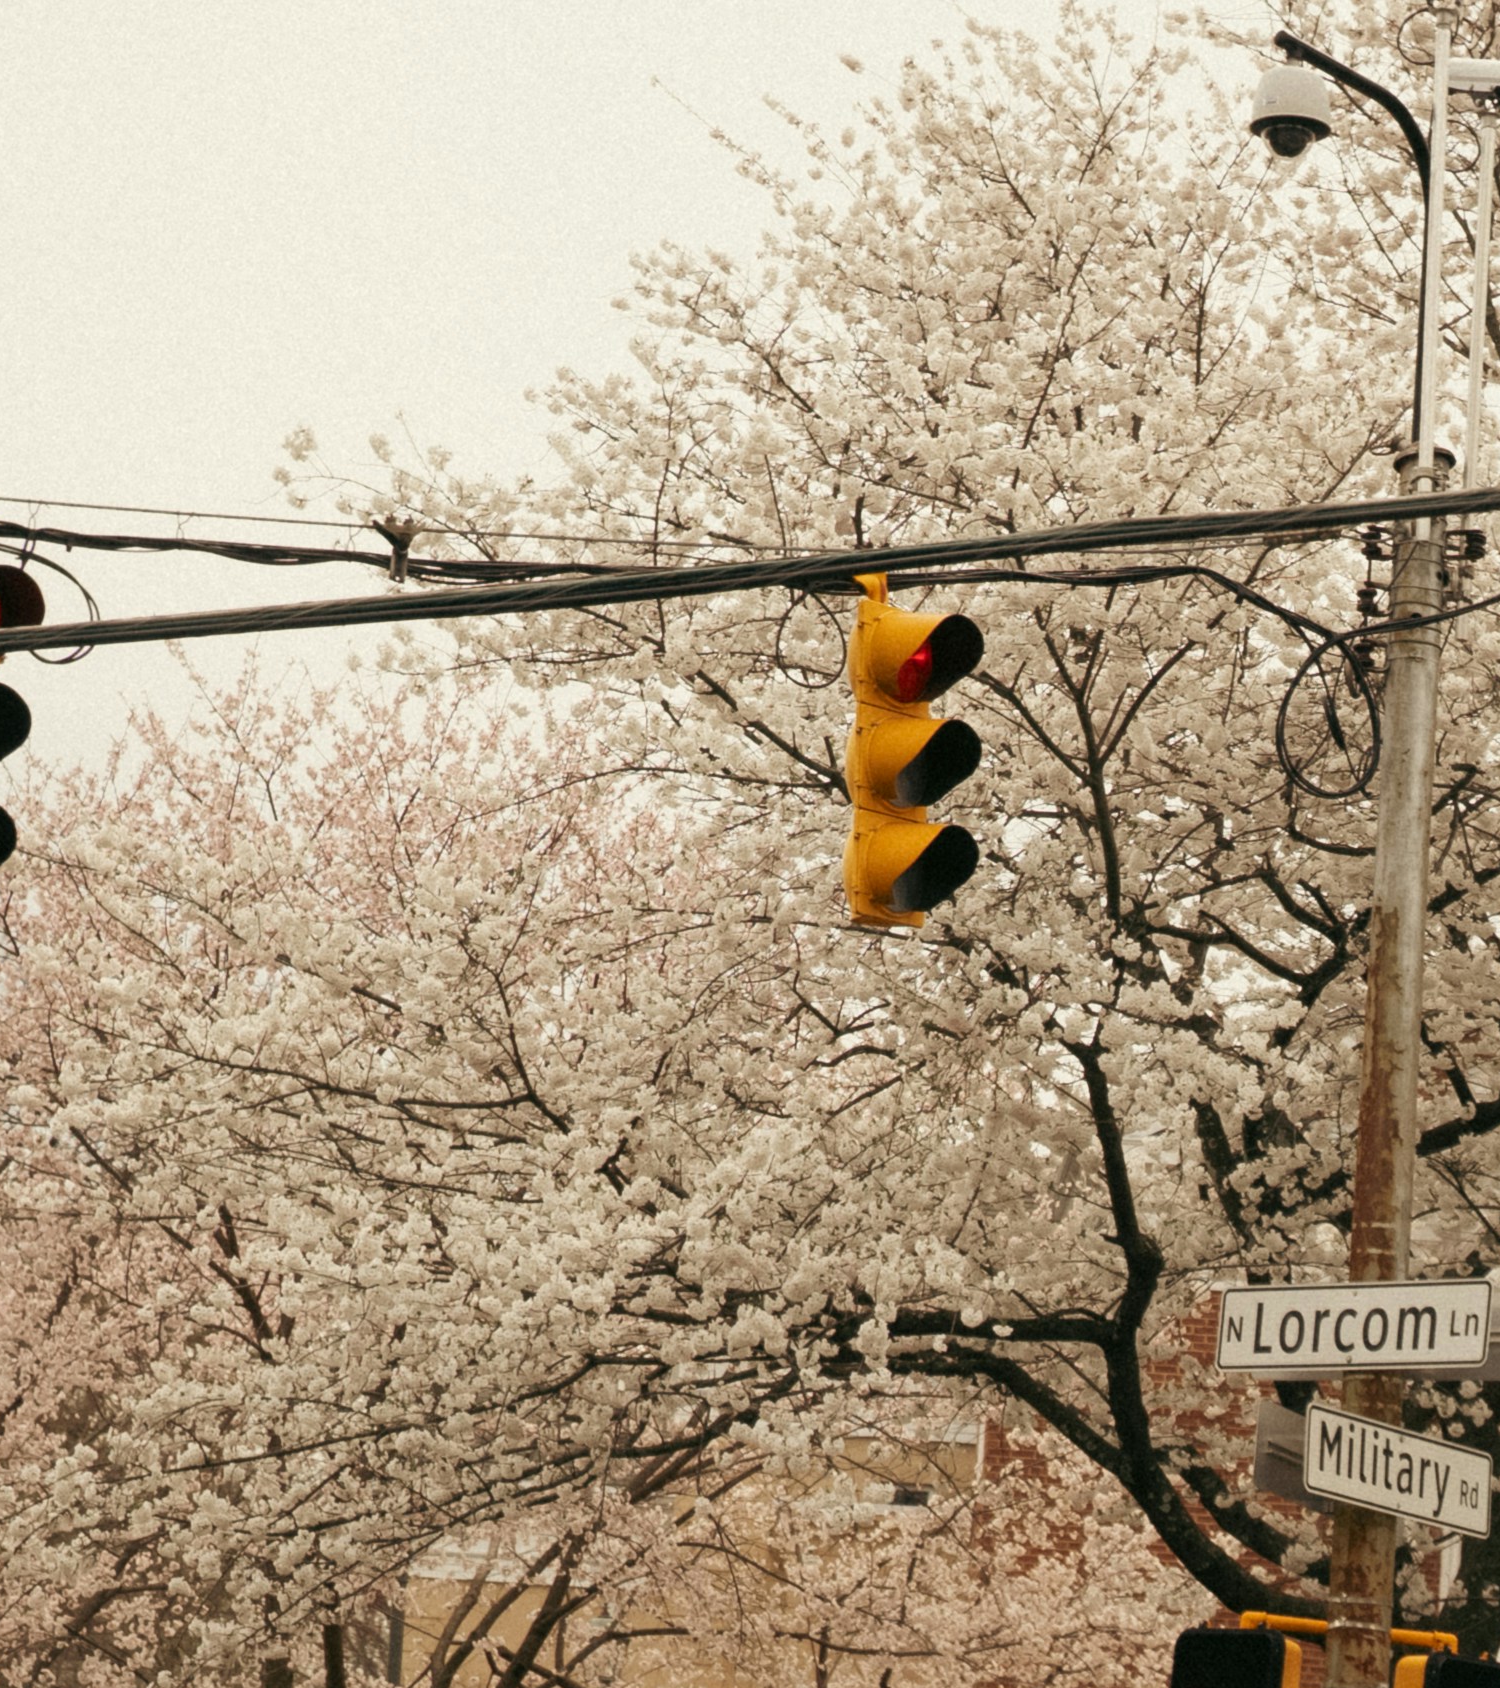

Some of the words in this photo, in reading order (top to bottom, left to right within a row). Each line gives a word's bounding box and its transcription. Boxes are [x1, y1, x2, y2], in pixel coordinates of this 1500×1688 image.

[1226, 1315, 1244, 1343] N
[1253, 1302, 1437, 1354] Lorcom
[1450, 1309, 1480, 1338] Ln
[1319, 1420, 1451, 1518] Military
[1460, 1479, 1480, 1510] Rd
